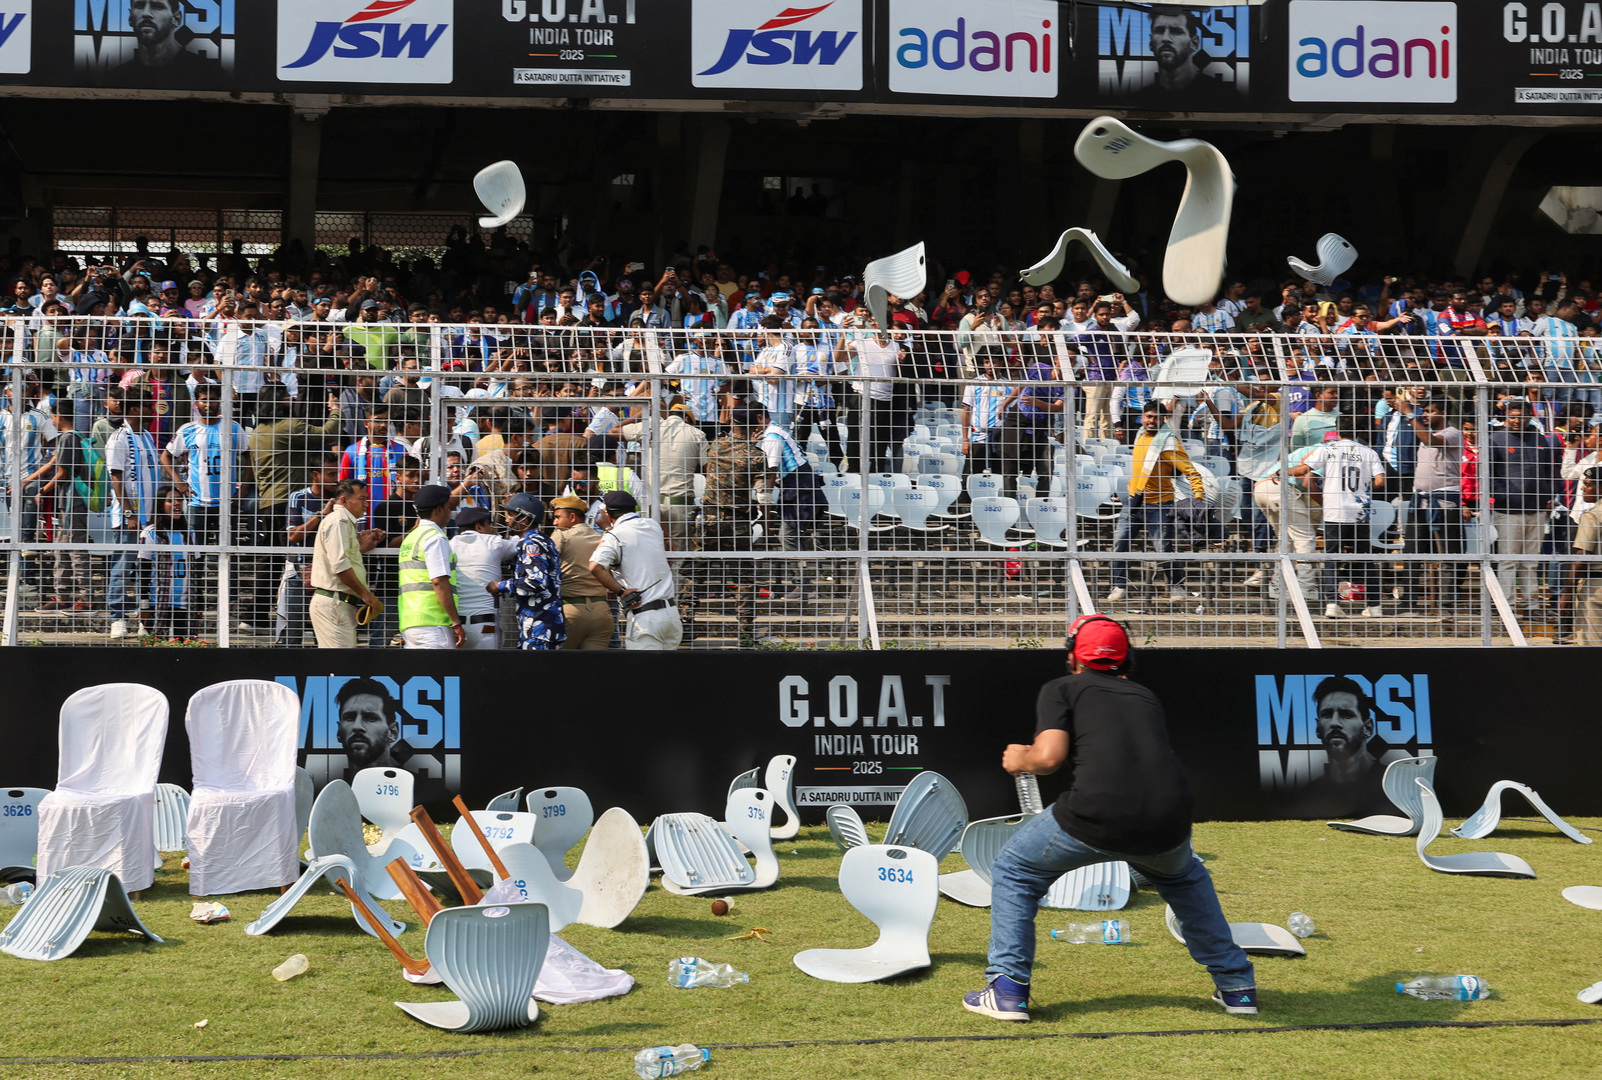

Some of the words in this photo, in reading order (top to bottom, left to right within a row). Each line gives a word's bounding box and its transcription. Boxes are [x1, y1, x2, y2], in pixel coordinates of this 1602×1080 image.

[530, 28, 570, 45] INDIA
[575, 28, 614, 45] TOUR
[282, 21, 449, 69] JSW
[696, 28, 858, 76] JSW
[897, 17, 1051, 74] adani
[1296, 24, 1450, 79] adani
[559, 49, 585, 60] 2025
[1530, 48, 1569, 65] INDIA
[517, 73, 523, 81] A
[524, 73, 557, 82] SATADRU
[559, 74, 583, 82] DUTTA
[1559, 69, 1584, 80] 2025
[1525, 92, 1558, 100] SATADRU
[1559, 92, 1582, 100] DUTTA
[1341, 465, 1361, 492] 10
[779, 675, 951, 728] G.O.A.T
[814, 734, 865, 756] INDIA
[871, 734, 918, 755] TOUR
[852, 761, 883, 774] 2025
[376, 784, 399, 796] 3796
[800, 792, 807, 803] A
[809, 792, 850, 803] SATADRU
[853, 791, 881, 803] DUTTA
[3, 804, 32, 817] 3626
[542, 804, 567, 818] 3799
[484, 826, 514, 839] 3792
[877, 866, 913, 884] 3634
